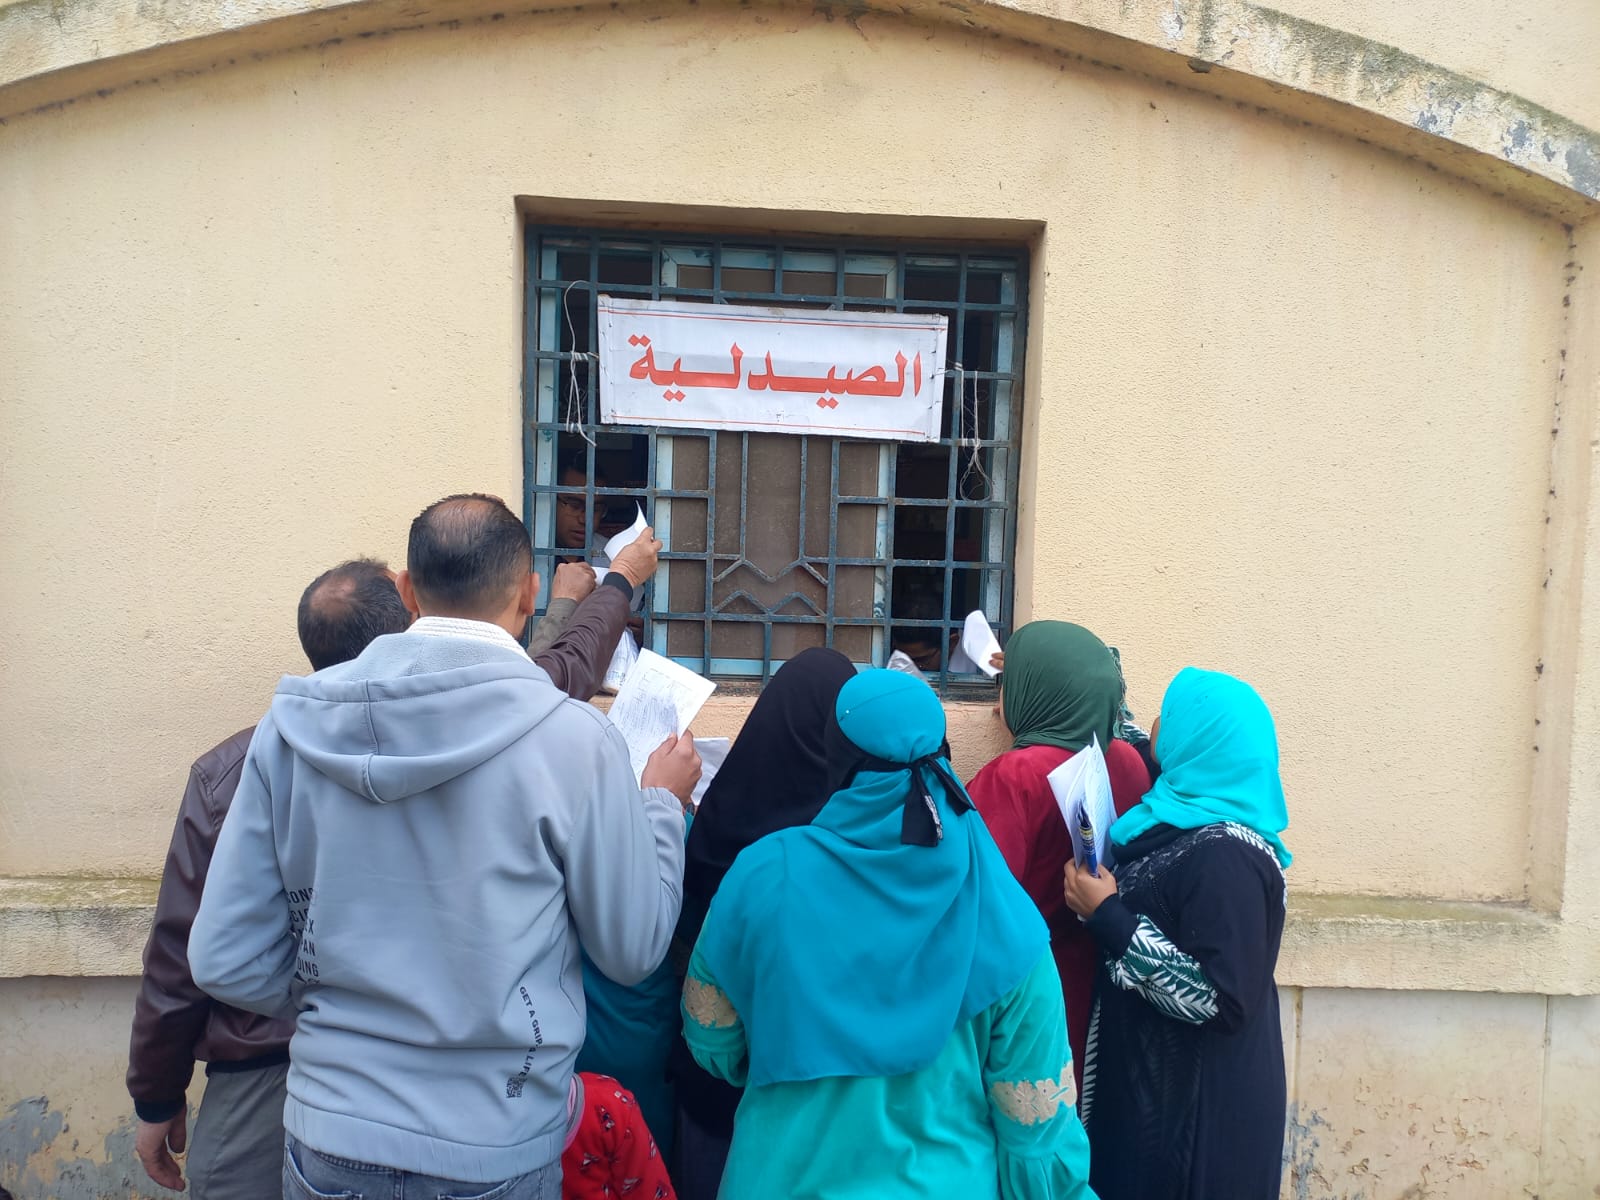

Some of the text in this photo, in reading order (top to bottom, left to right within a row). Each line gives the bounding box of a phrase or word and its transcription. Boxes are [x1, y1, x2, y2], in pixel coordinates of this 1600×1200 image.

[628, 334, 921, 410] الصيدلية
[288, 887, 314, 904] ON
[300, 939, 316, 956] AN
[520, 986, 532, 1006] GET
[529, 1009, 536, 1018] A
